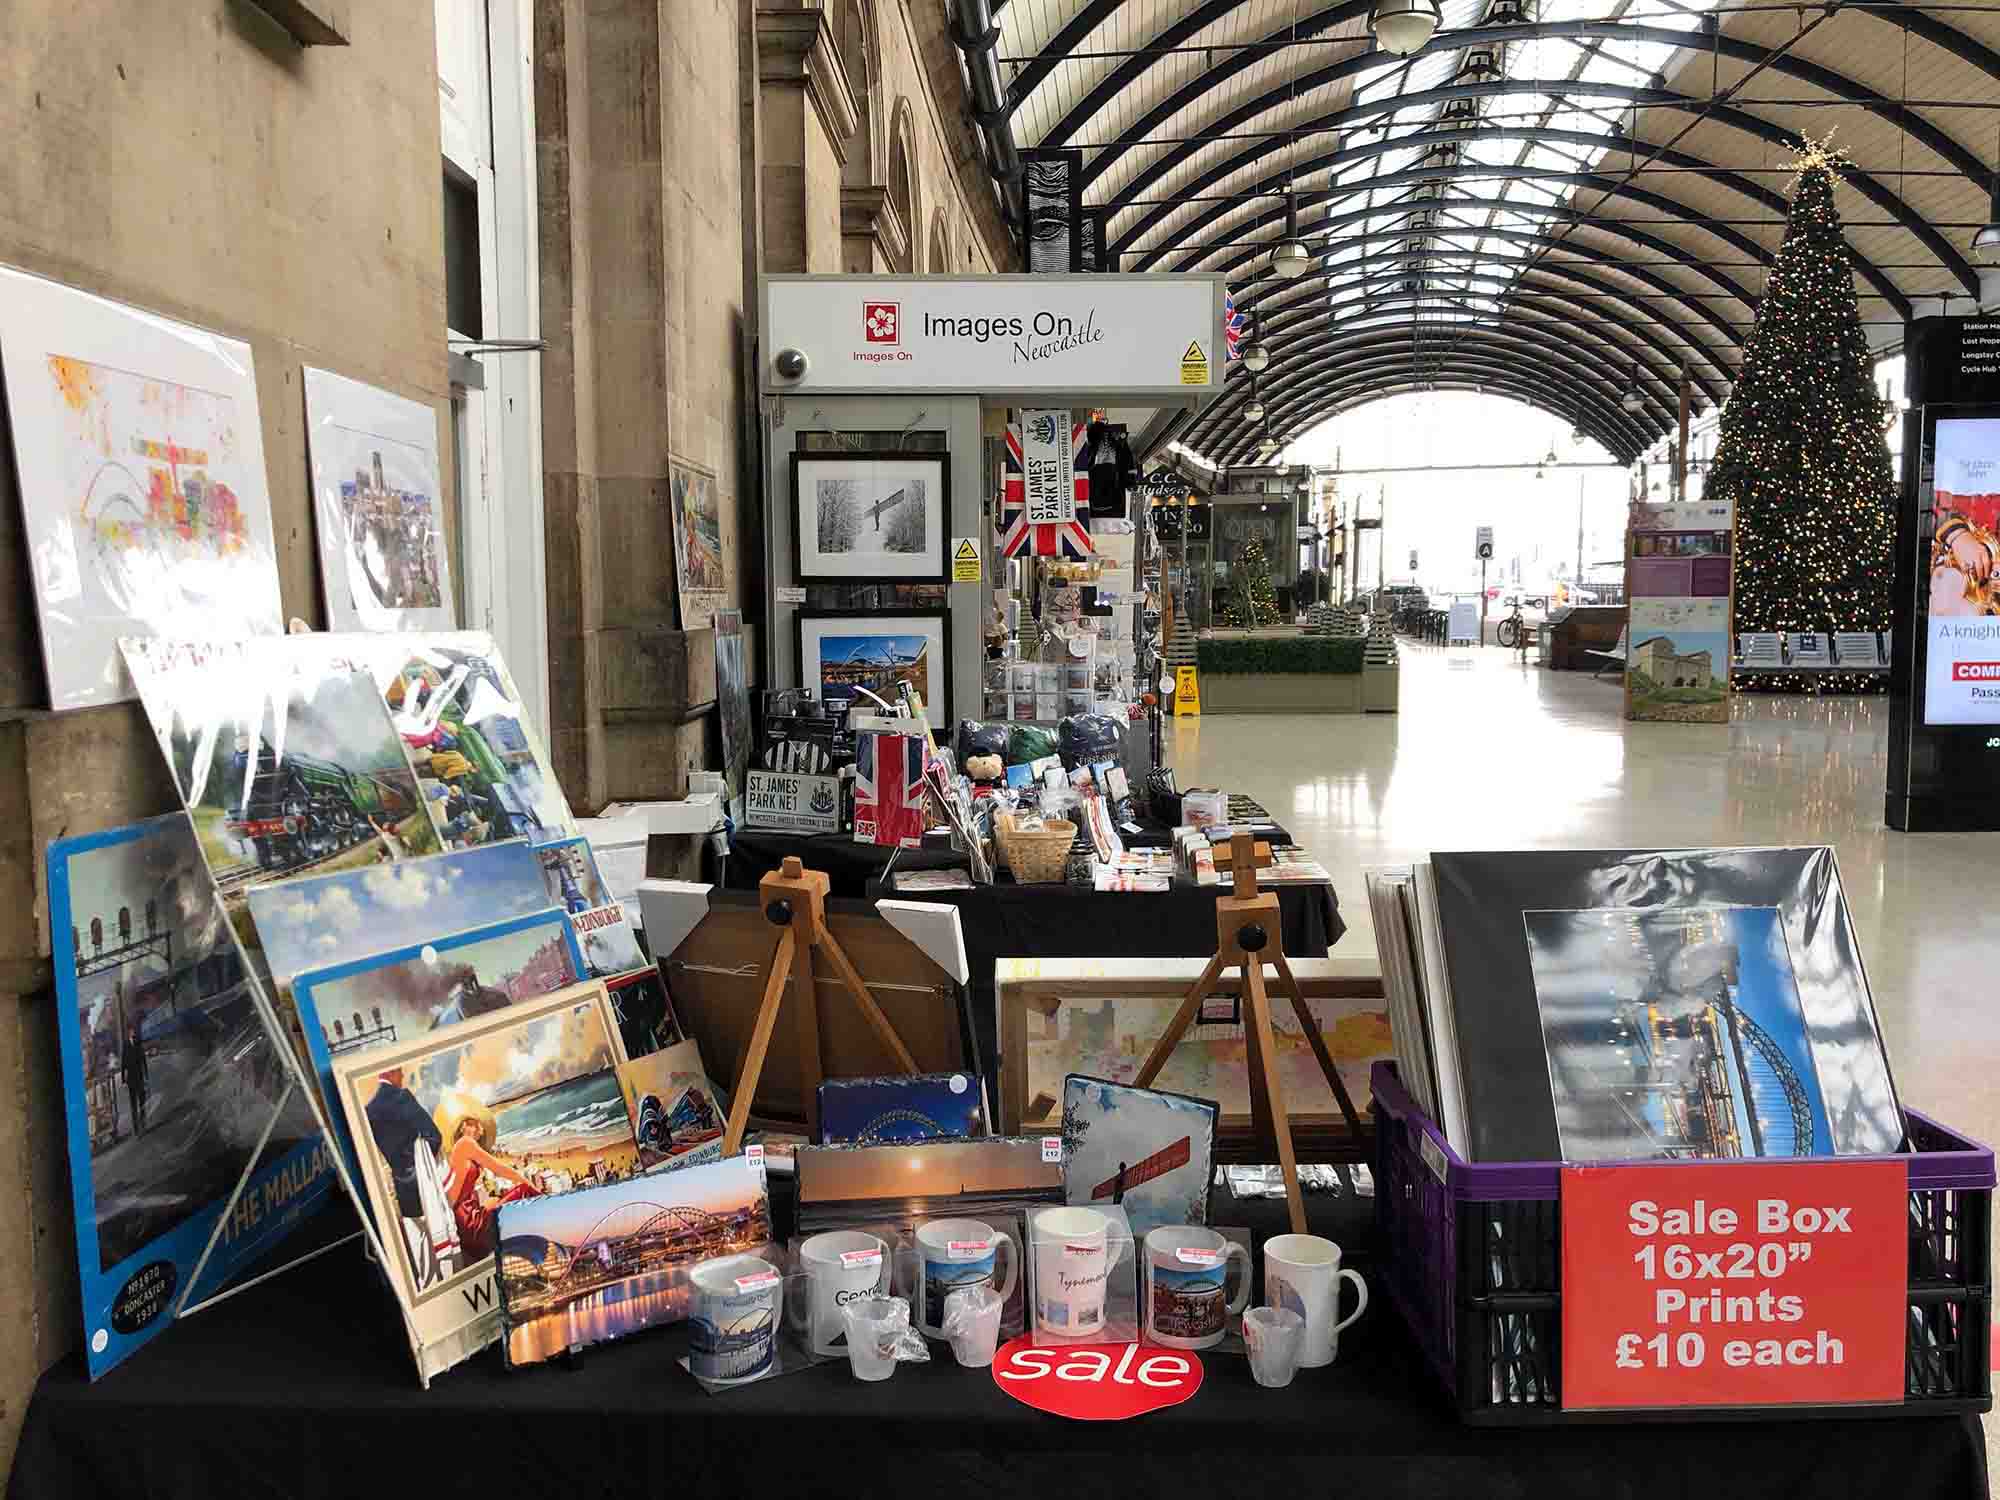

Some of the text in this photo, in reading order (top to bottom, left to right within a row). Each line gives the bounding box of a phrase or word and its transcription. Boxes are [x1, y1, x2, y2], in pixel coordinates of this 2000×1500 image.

[924, 312, 1073, 342] Images On
[1012, 305, 1104, 365] Newcastle
[853, 351, 913, 363] Images On
[1043, 460, 1059, 519] PARK NE1
[1031, 501, 1044, 520] ST.
[749, 791, 797, 811] PARK NE1
[750, 776, 763, 792] ST.
[1628, 1199, 1852, 1236] Sale Box
[1656, 1288, 1804, 1323] Prints
[1000, 1343, 1190, 1387] sale
[1615, 1330, 1843, 1368] £10 each
